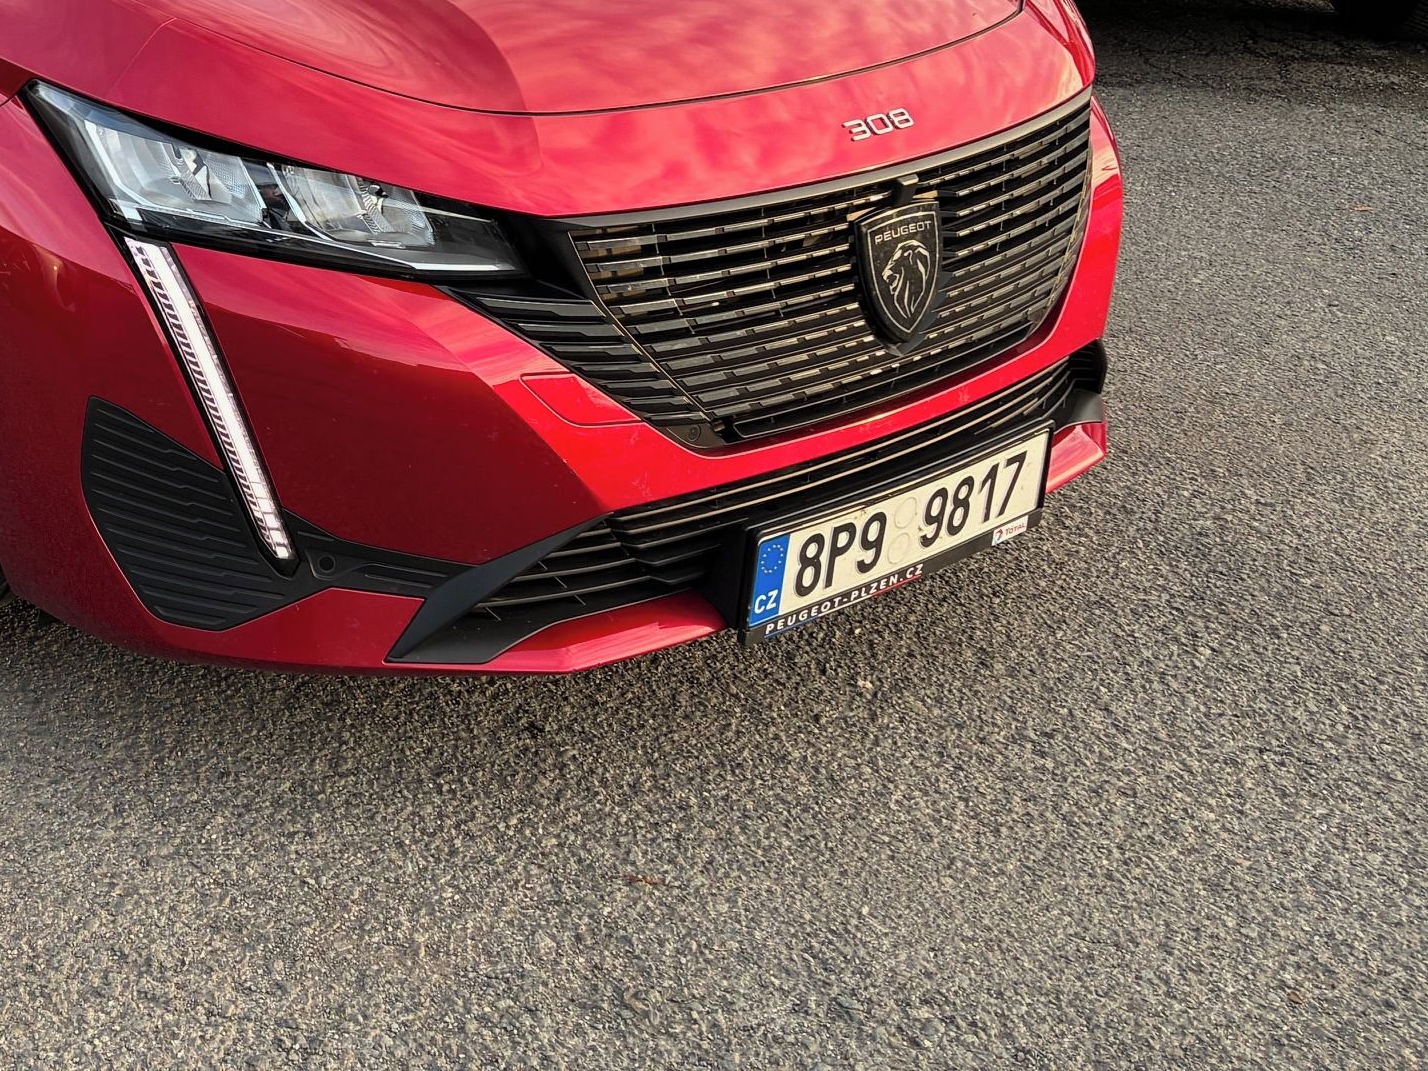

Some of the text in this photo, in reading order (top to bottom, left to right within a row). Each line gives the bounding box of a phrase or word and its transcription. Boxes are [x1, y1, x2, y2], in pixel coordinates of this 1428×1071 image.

[842, 108, 914, 141] 308
[874, 221, 932, 245] PEUGEOT
[794, 450, 1028, 597] 8P9 9817
[1005, 523, 1026, 536] TOTAL
[754, 589, 779, 615] CZ
[765, 563, 924, 635] PEUGEOT-PLZEN.CZ
